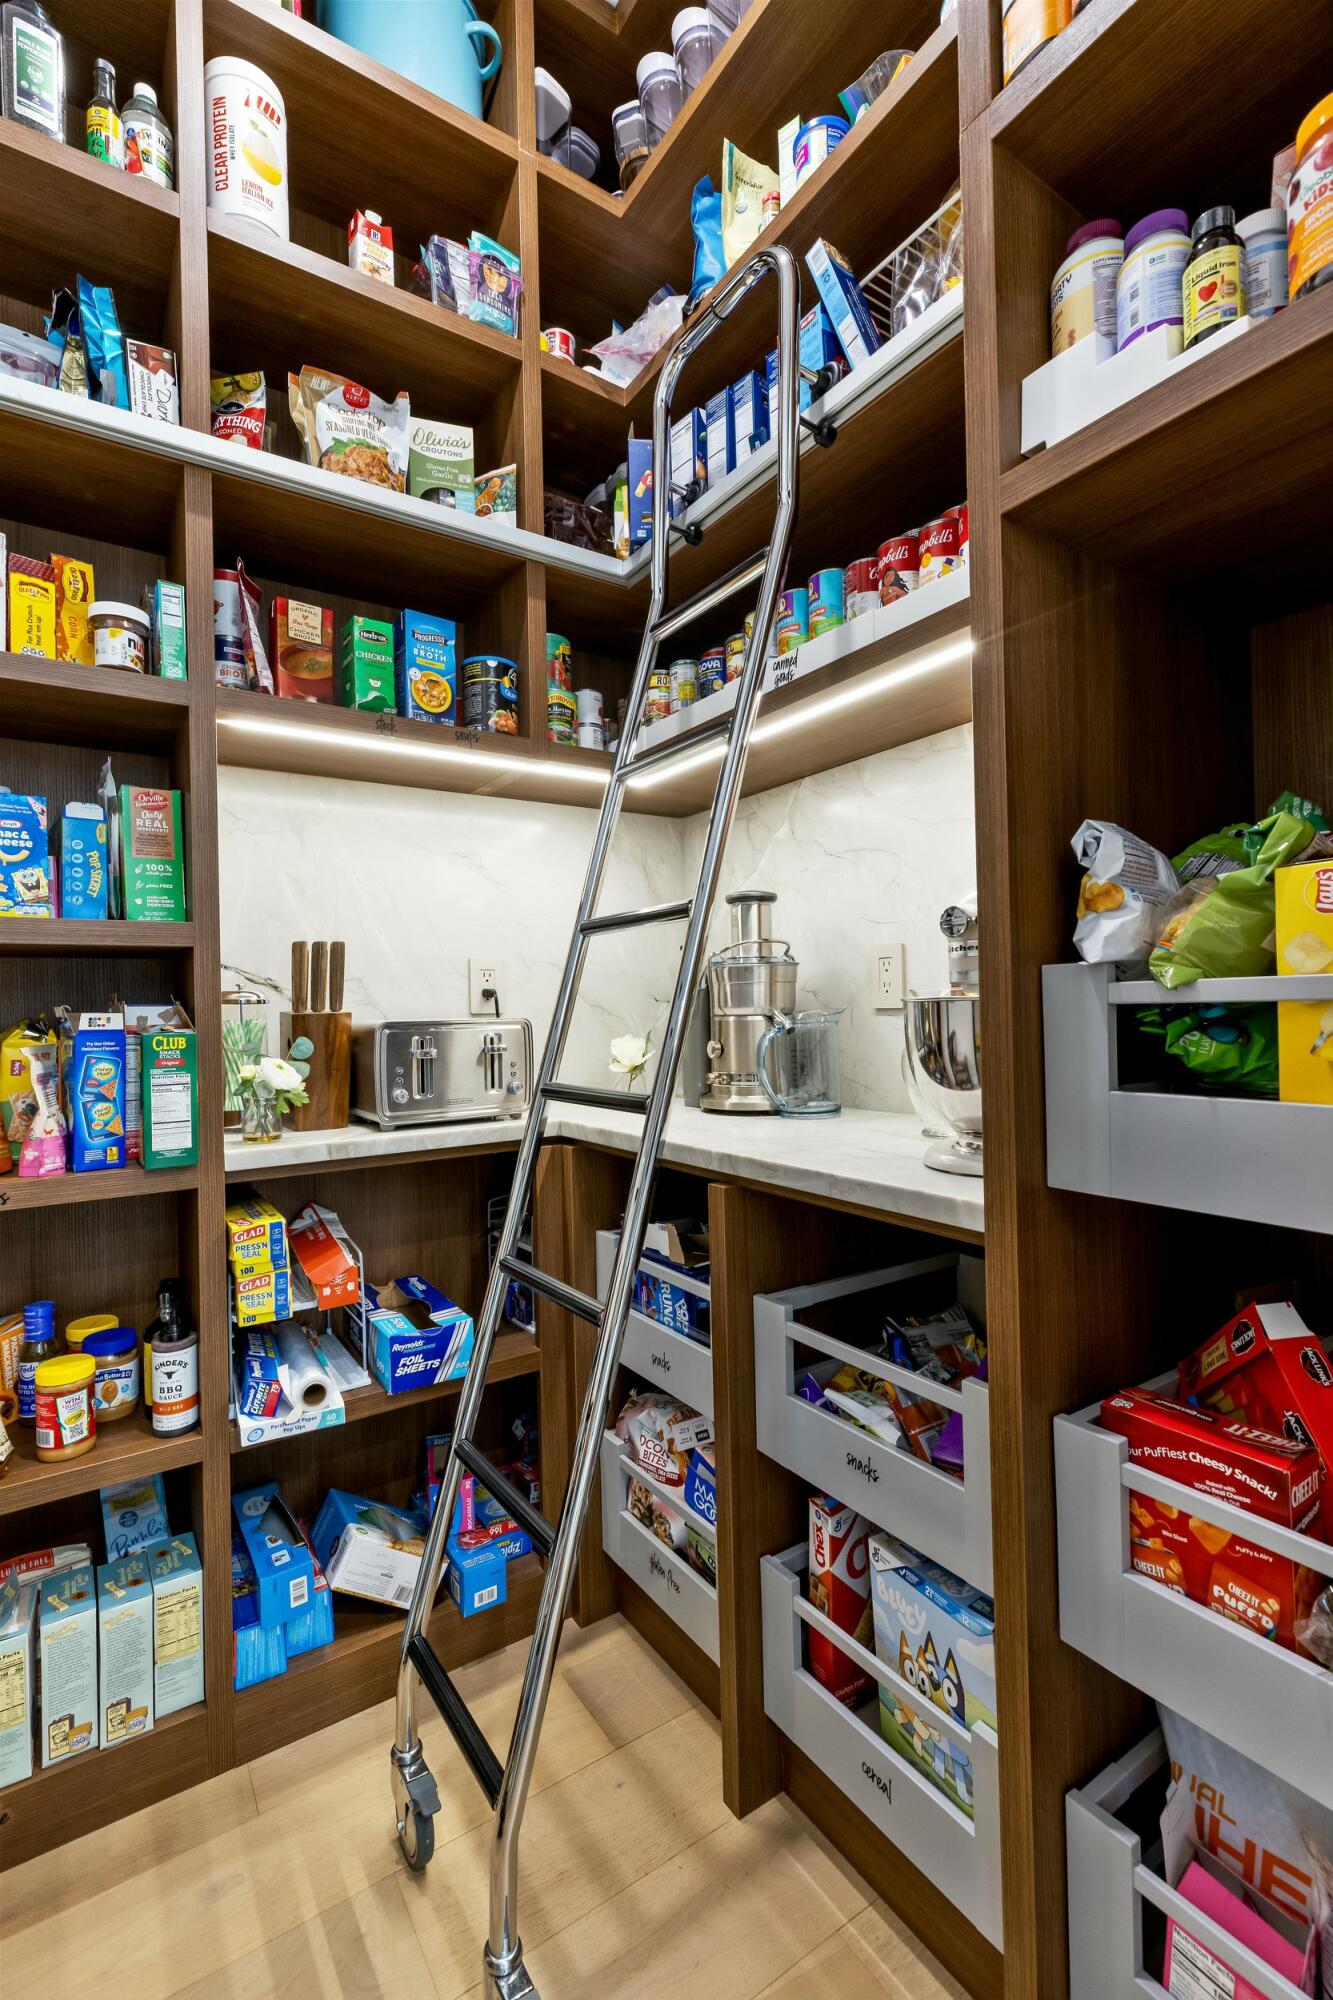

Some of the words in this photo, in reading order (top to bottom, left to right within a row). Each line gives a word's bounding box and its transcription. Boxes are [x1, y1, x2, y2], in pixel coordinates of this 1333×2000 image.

[212, 96, 227, 150] PROTEIN
[214, 151, 229, 192] CLEAR
[242, 179, 263, 193] LEMON
[1192, 263, 1218, 283] Liquid
[1219, 260, 1237, 269] Iron
[413, 427, 471, 449] Olivia's
[420, 445, 464, 458] CROUTONS
[426, 462, 446, 472] Gluten
[446, 465, 459, 474] Free
[432, 470, 454, 480] Garlic
[291, 607, 319, 618] ORGANIC
[69, 616, 78, 639] CORN
[290, 626, 321, 639] CHICKEN
[293, 633, 316, 642] BROTH
[414, 633, 445, 644] PROGRESSO
[413, 648, 447, 663] BROTH
[416, 643, 443, 655] CHICKEN
[355, 650, 393, 663] CHICKEN
[138, 793, 164, 802] Orville
[141, 810, 162, 820] Only
[136, 819, 169, 828] REAL
[145, 864, 172, 872] 100%
[152, 1035, 187, 1051] CLUB
[233, 1227, 265, 1243] GLAD
[241, 1251, 262, 1259] SEAL
[240, 1266, 254, 1275] 100
[239, 1277, 269, 1292] GLAD
[246, 1300, 266, 1308] SEAL
[242, 1315, 256, 1324] 100
[392, 1340, 426, 1353] Reynolds
[399, 1354, 425, 1367] FOIL
[1304, 1347, 1318, 1366] JACK
[154, 1360, 189, 1372] KINDER'S
[395, 1359, 441, 1377] SHEETS
[455, 1361, 469, 1369] 500
[159, 1384, 183, 1394] BBQ
[270, 1384, 280, 1393] 75
[65, 1395, 82, 1405] WIN
[159, 1393, 183, 1401] SAUCE
[243, 1389, 256, 1414] Reynolds
[301, 1415, 317, 1423] Paper
[326, 1413, 336, 1421] 40
[1284, 1410, 1306, 1443] JACK
[643, 1449, 669, 1468] BITES
[1144, 1447, 1188, 1461] Puffiest
[1188, 1451, 1233, 1476] Cheesy
[1233, 1468, 1278, 1501] Snack!
[1193, 1482, 1211, 1492] 100%
[1211, 1487, 1226, 1496] Real
[1226, 1491, 1251, 1504] Cheese
[1205, 1480, 1222, 1489] Baked
[1222, 1484, 1236, 1493] with
[1292, 1470, 1320, 1509] CHEEZ-IT
[110, 1518, 170, 1557] Pamela's
[489, 1526, 503, 1536] 166
[1161, 1529, 1172, 1537] Bite
[1172, 1532, 1188, 1543] Sized
[814, 1524, 826, 1568] Chex
[1235, 1545, 1254, 1557] Puffy
[1259, 1553, 1273, 1563] Airy
[29, 1556, 50, 1568] FREE
[1133, 1558, 1166, 1579] CHEEZ-IT
[667, 1569, 681, 1595] free
[157, 1588, 180, 1602] Nutrition
[181, 1584, 197, 1595] Facts
[1228, 1582, 1260, 1608] CHEEZ-IT
[876, 1574, 929, 1636] Bluey
[1212, 1584, 1275, 1629] PUFF'D
[3, 1650, 20, 1661] Facts
[862, 1761, 893, 1806] cereal
[1174, 1926, 1209, 1961] Nutrition
[1211, 1958, 1235, 1983] Facts
